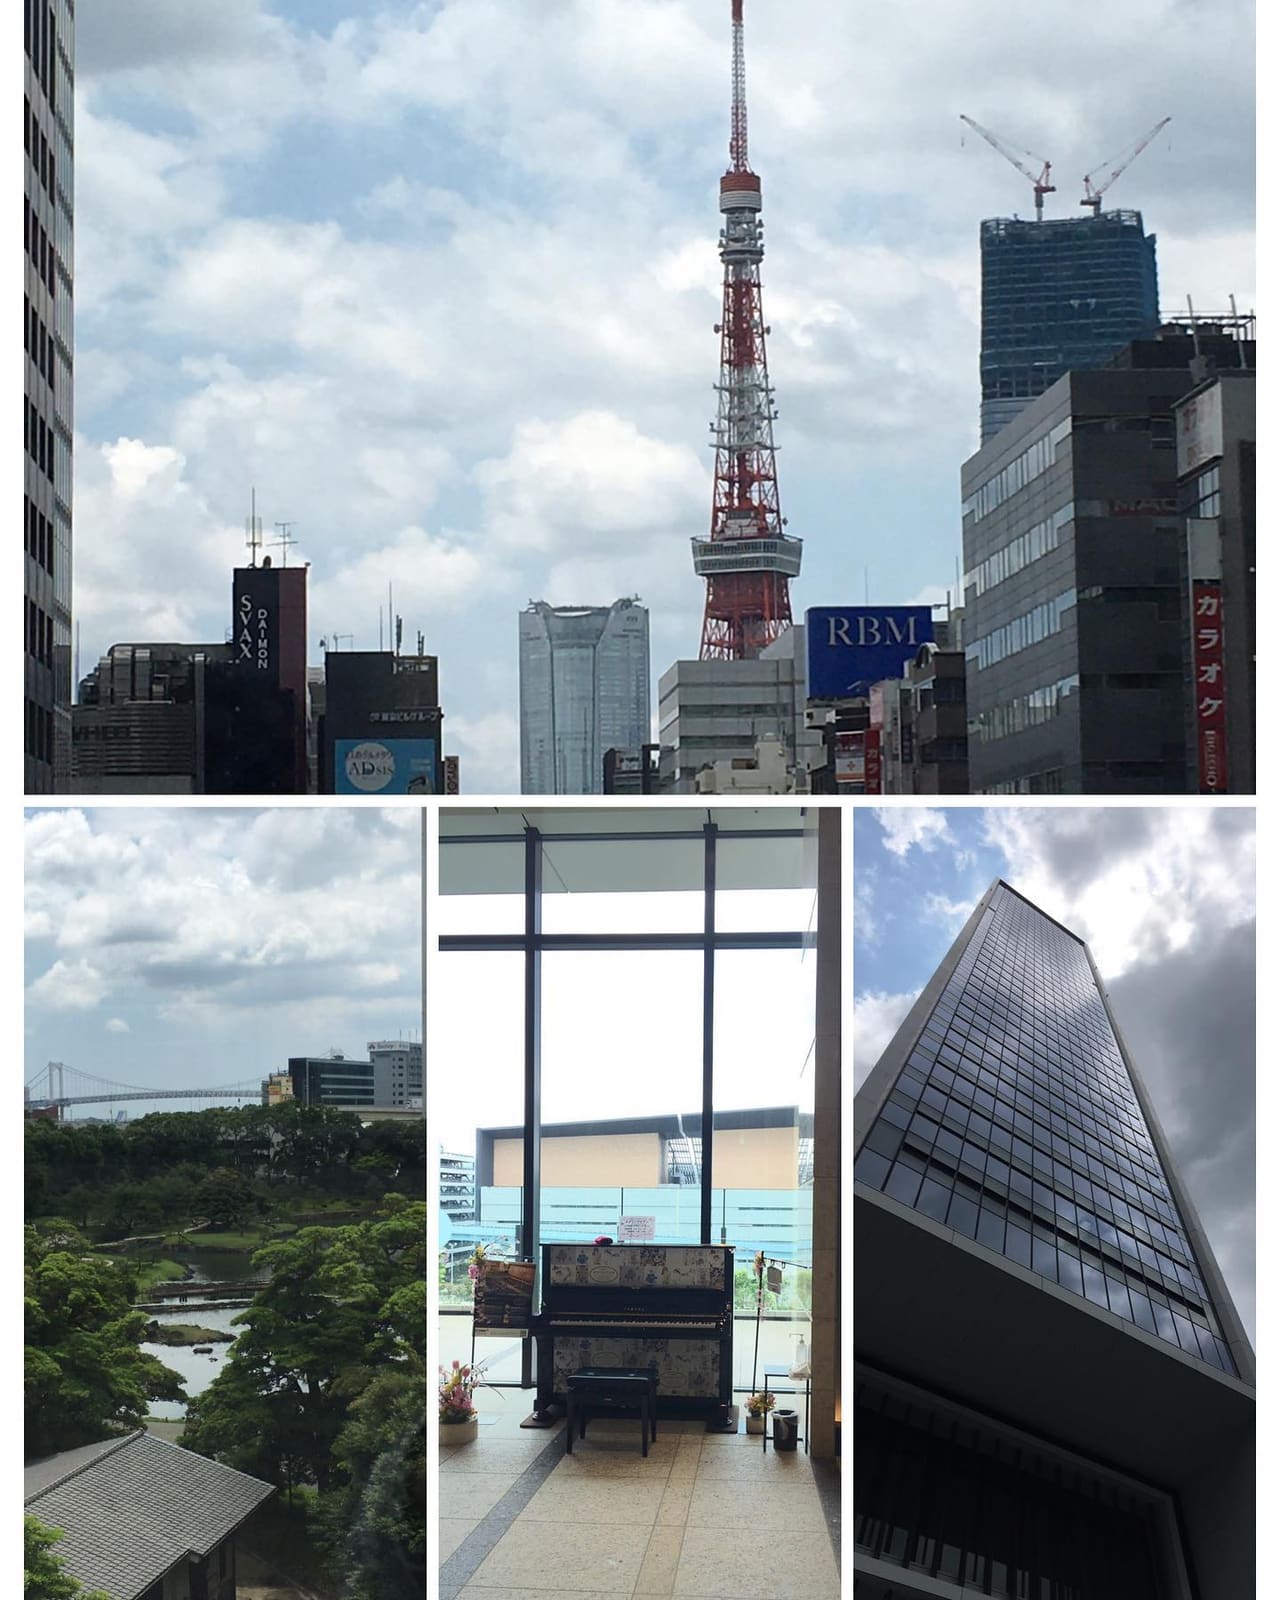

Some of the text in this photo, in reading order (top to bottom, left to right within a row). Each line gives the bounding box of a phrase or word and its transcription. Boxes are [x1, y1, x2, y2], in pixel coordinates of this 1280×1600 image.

[240, 594, 252, 659] SVAX
[258, 608, 268, 669] DAIMON
[828, 615, 917, 646] RBM
[1197, 595, 1223, 717] カラオケ
